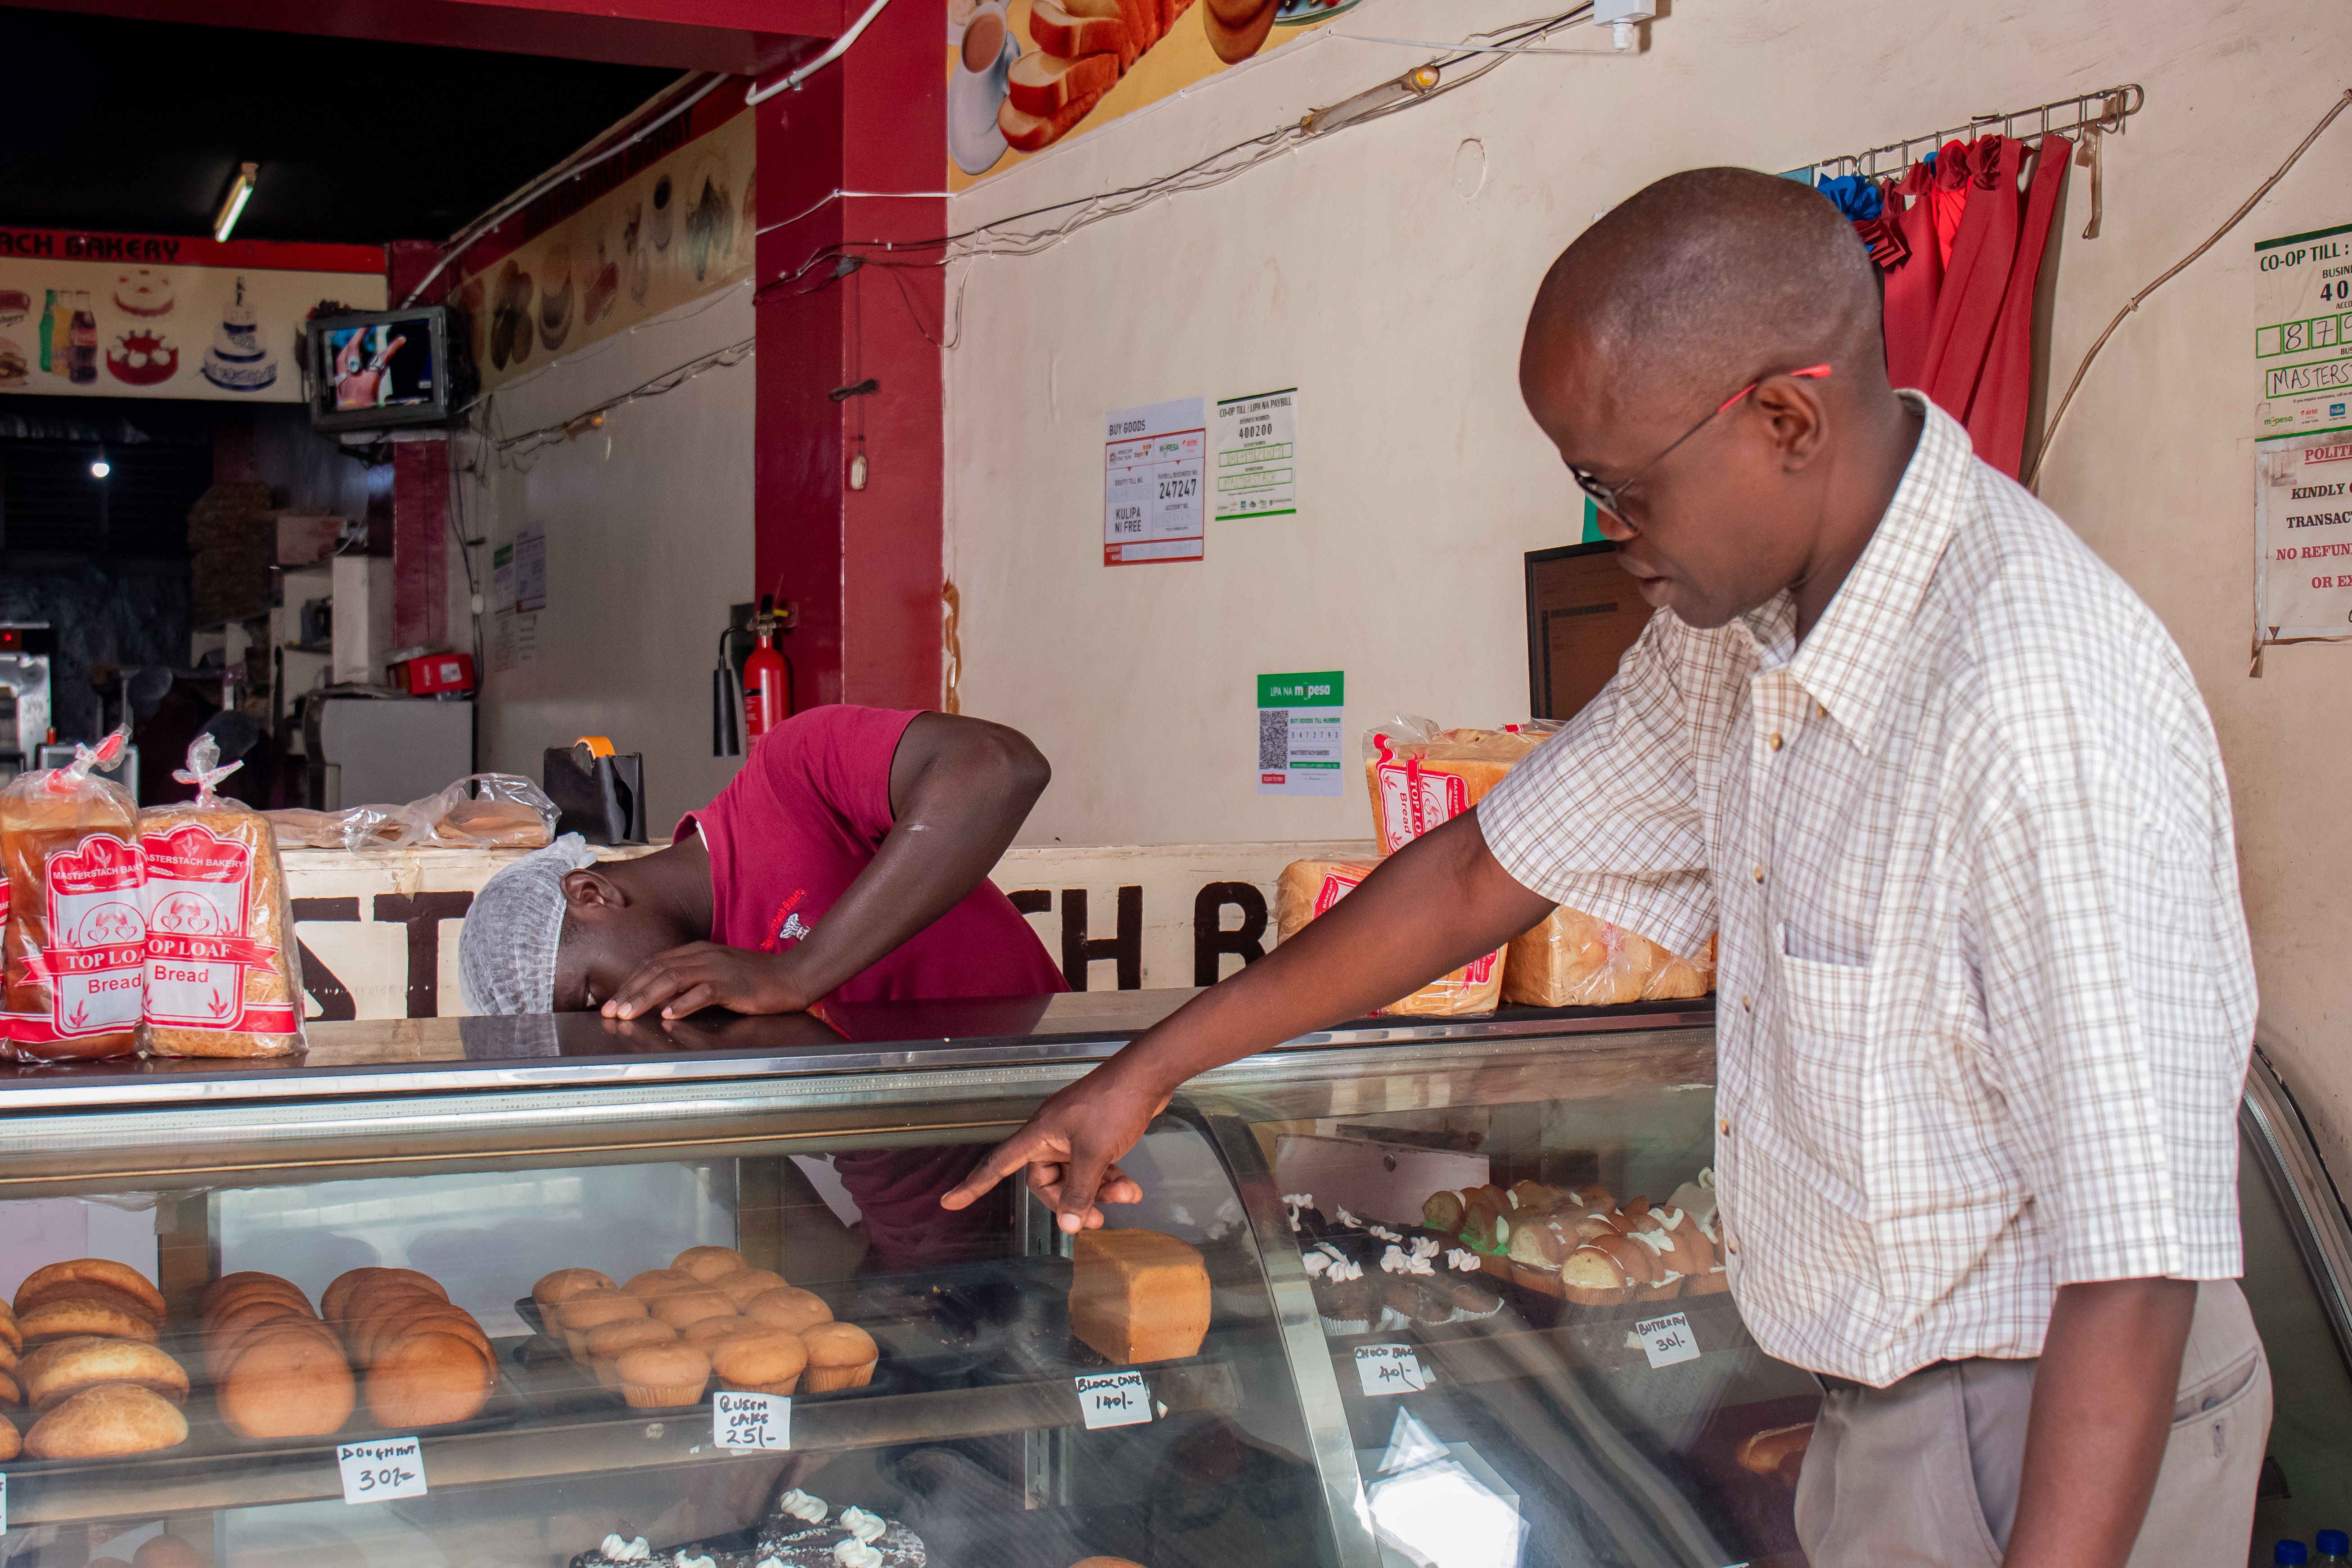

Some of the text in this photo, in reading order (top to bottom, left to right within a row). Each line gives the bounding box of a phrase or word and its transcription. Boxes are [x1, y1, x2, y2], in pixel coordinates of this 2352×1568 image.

[66, 235, 180, 261] BAKERY
[2260, 248, 2306, 272] CO-OP
[2310, 242, 2341, 261] TILL
[2274, 363, 2352, 395] MASTERS
[1219, 407, 1235, 418] CO-OP
[1236, 406, 1247, 415] TILL
[1250, 403, 1261, 412] LIPA
[1262, 401, 1270, 410] NA
[1271, 397, 1292, 408] PAYBILL
[1109, 419, 1146, 436] BUY GOODS
[1239, 423, 1272, 439] 400200
[1159, 478, 1197, 500] 247247
[2291, 482, 2346, 500] KINDLY
[1116, 507, 1141, 520] KULIPA
[2286, 511, 2352, 529] TRANSAC
[1115, 519, 1141, 534] NI FREE
[2276, 544, 2352, 561] NO REFUN
[2311, 577, 2333, 589] OR
[1270, 687, 1282, 696] LIPA
[1284, 687, 1293, 696] NA
[1400, 792, 1412, 834] Bread
[1410, 779, 1422, 836] TOP LO
[206, 858, 245, 868] BAKERY
[53, 867, 118, 880] MASTERSTACH
[1323, 879, 1334, 909] BAKERY
[179, 939, 232, 958] LOAF
[66, 952, 105, 969] TOP
[155, 964, 209, 983] Bread
[88, 973, 142, 994] Bread
